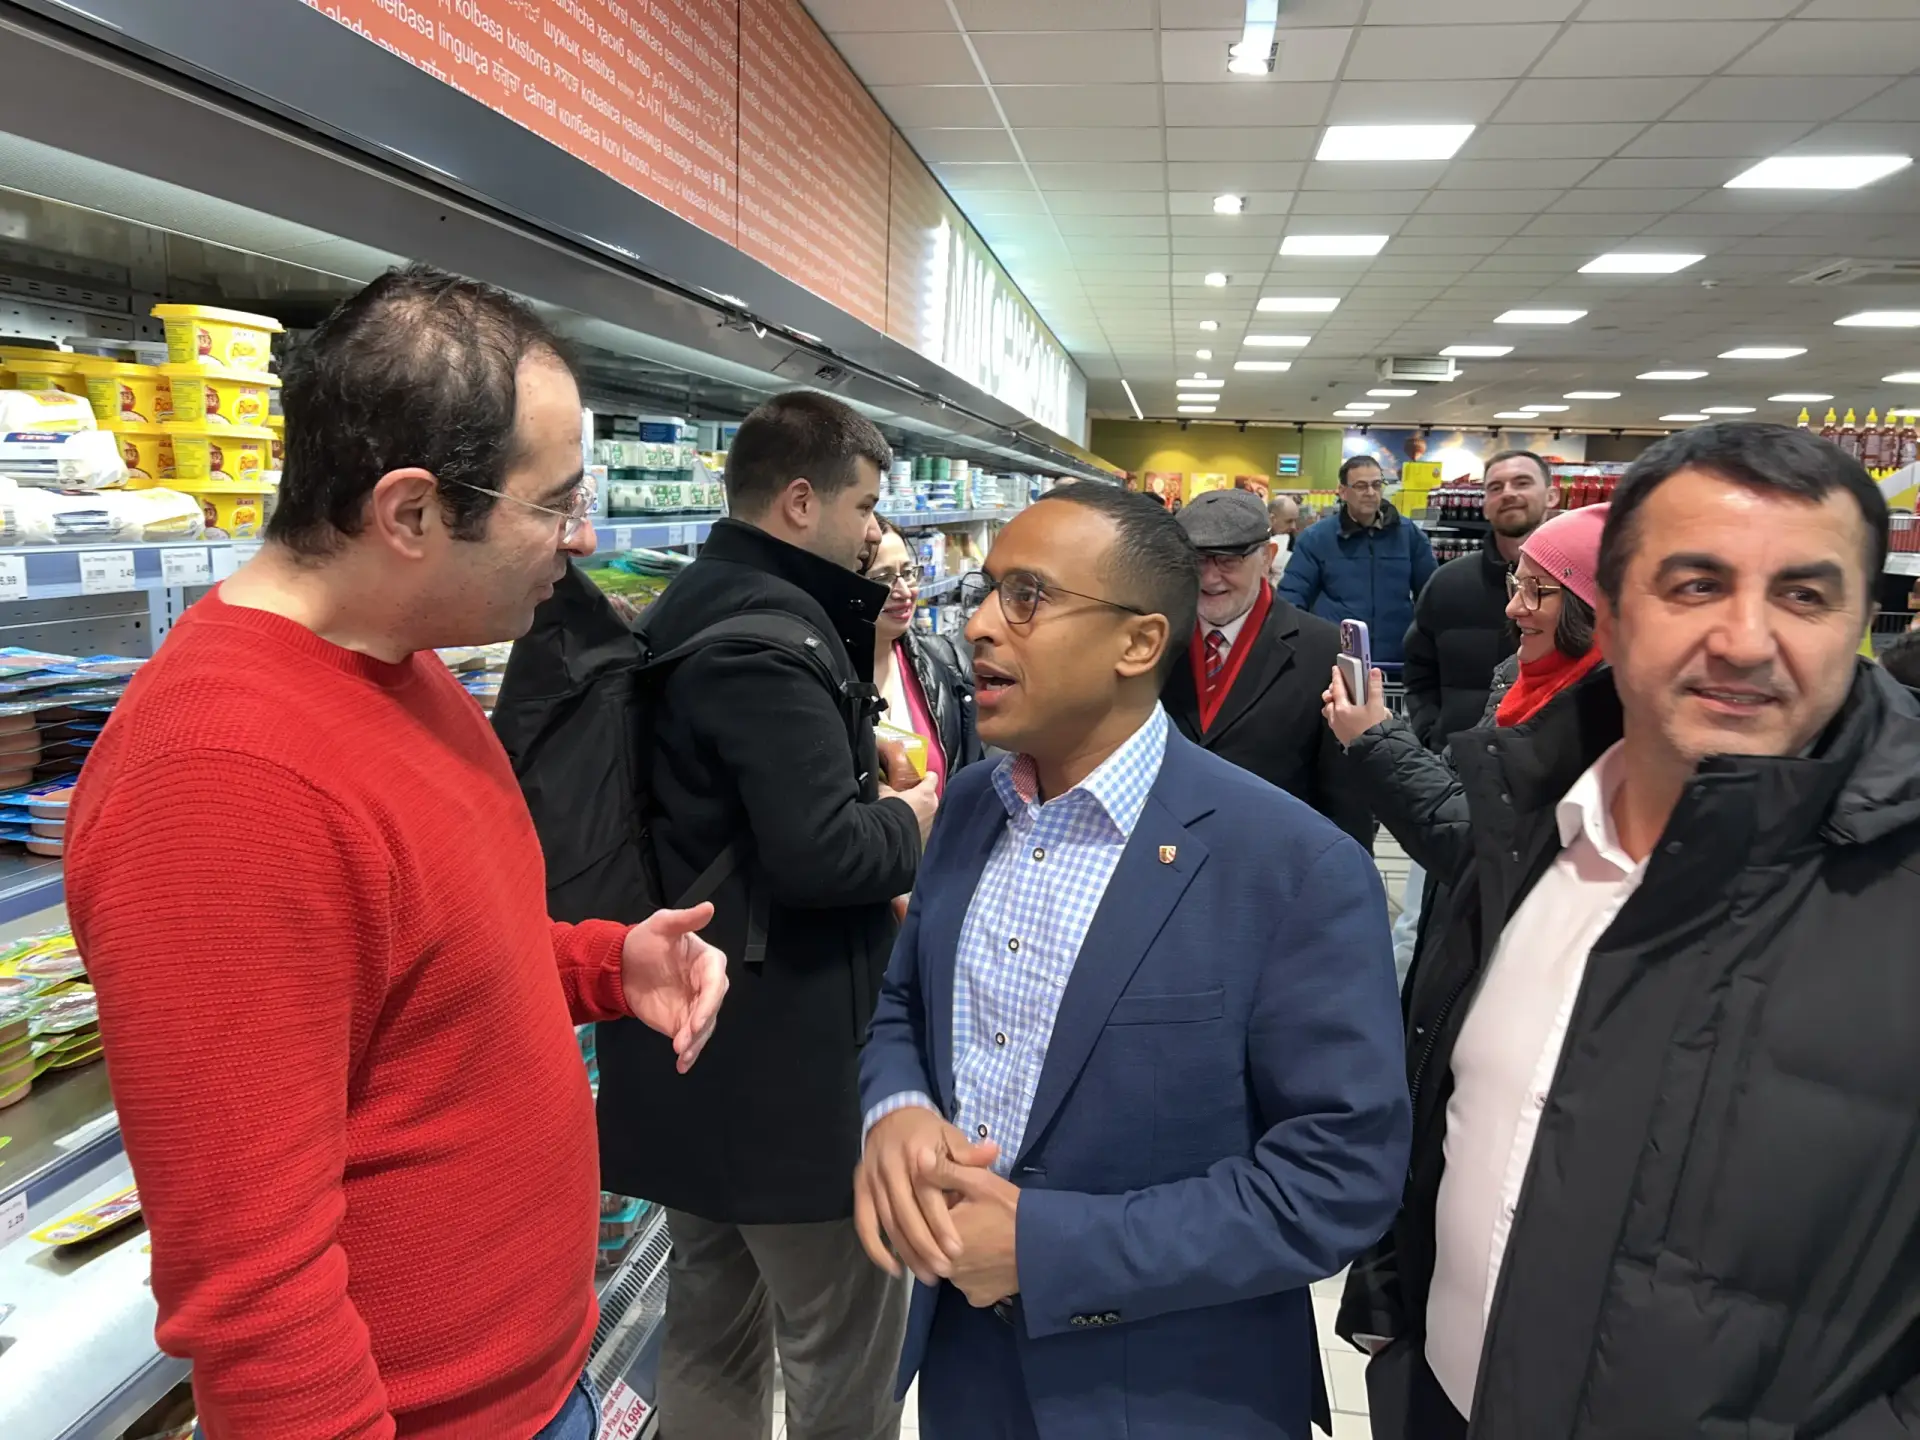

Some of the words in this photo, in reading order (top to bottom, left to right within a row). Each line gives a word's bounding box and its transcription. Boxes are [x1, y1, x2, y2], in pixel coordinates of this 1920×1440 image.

[438, 21, 488, 75] linguiça
[456, 0, 503, 43] kolbasa
[507, 27, 550, 76] txistorra
[630, 17, 663, 56] makkara
[582, 47, 615, 86] salsitxa
[581, 80, 620, 124] kobasica
[636, 87, 663, 122] 소시지
[559, 107, 600, 146] колбаса
[602, 131, 620, 158] korv
[663, 143, 692, 175] sausage
[618, 1399, 647, 1439] 14,99€
